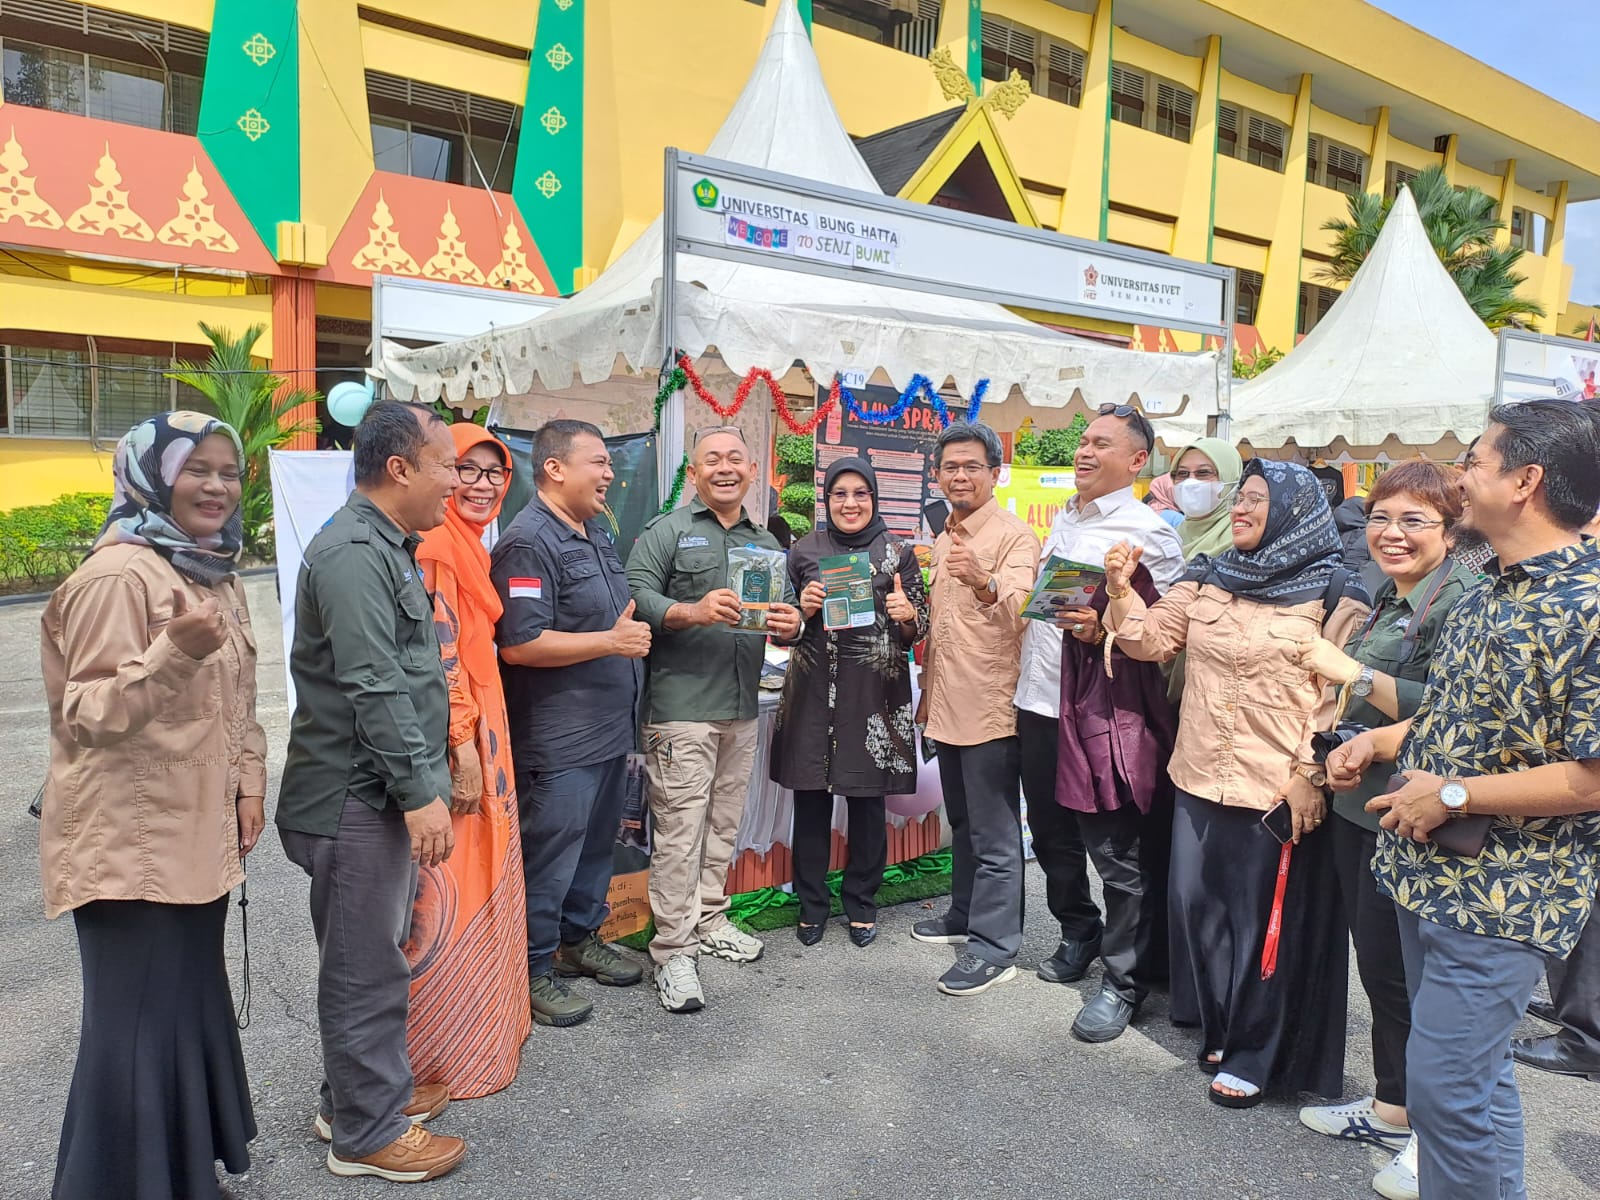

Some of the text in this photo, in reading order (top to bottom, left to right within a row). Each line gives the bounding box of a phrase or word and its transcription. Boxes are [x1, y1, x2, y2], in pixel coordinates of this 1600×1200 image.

[721, 195, 898, 244] UNIVERSITAS BUNG HATTA
[729, 218, 890, 264] WELCOME TO SENI BUMI
[1101, 274, 1182, 296] UNIVERSITAS IVET
[1110, 290, 1172, 305] SEMARANG
[844, 371, 865, 386] C19
